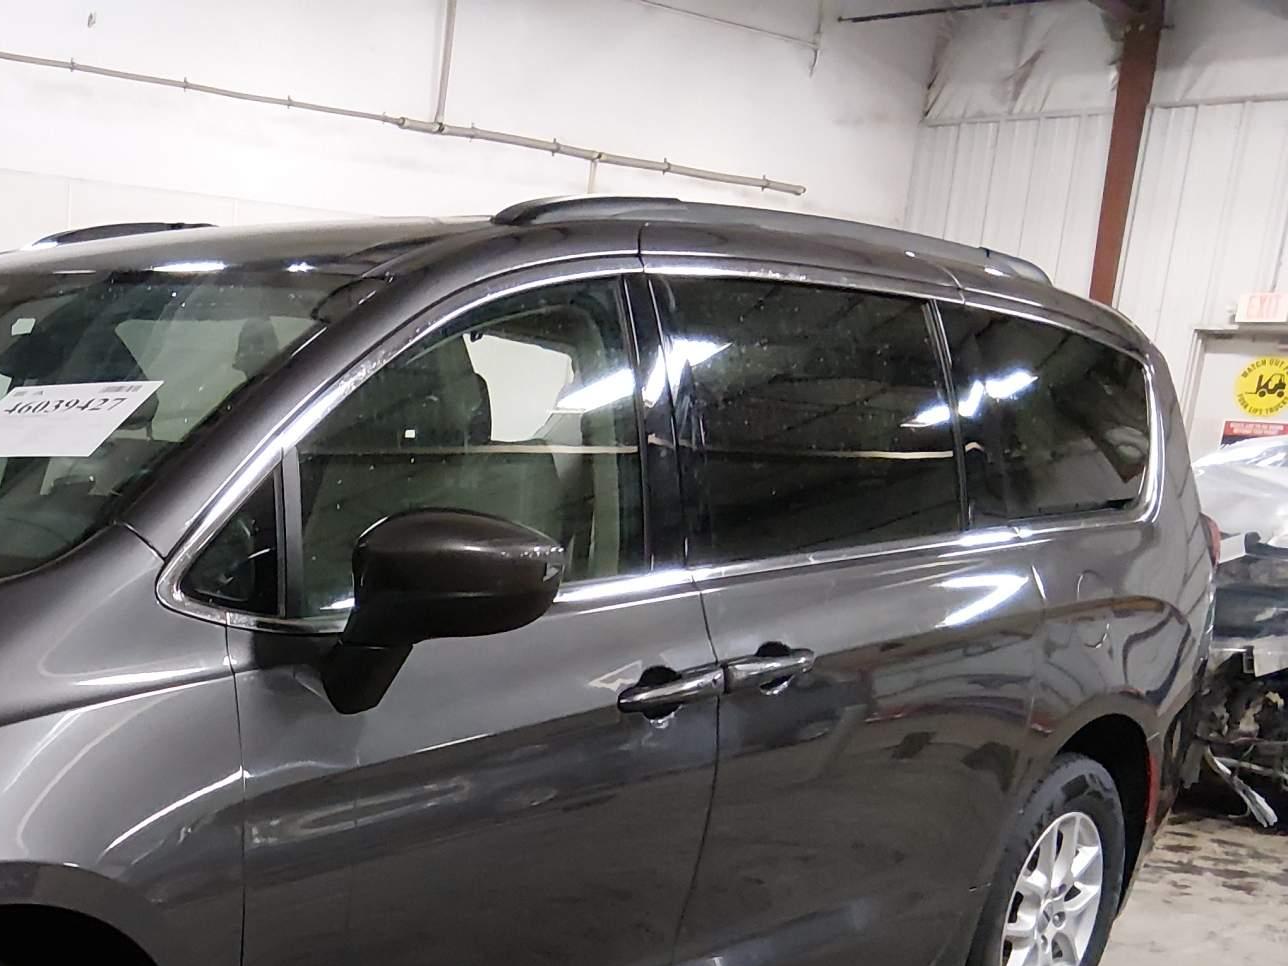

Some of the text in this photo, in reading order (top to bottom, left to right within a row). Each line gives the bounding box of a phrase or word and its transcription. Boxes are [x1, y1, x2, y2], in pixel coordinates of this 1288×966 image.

[1246, 294, 1282, 319] EXIT
[1241, 359, 1267, 378] WATCH
[4, 396, 129, 415] 46039427
